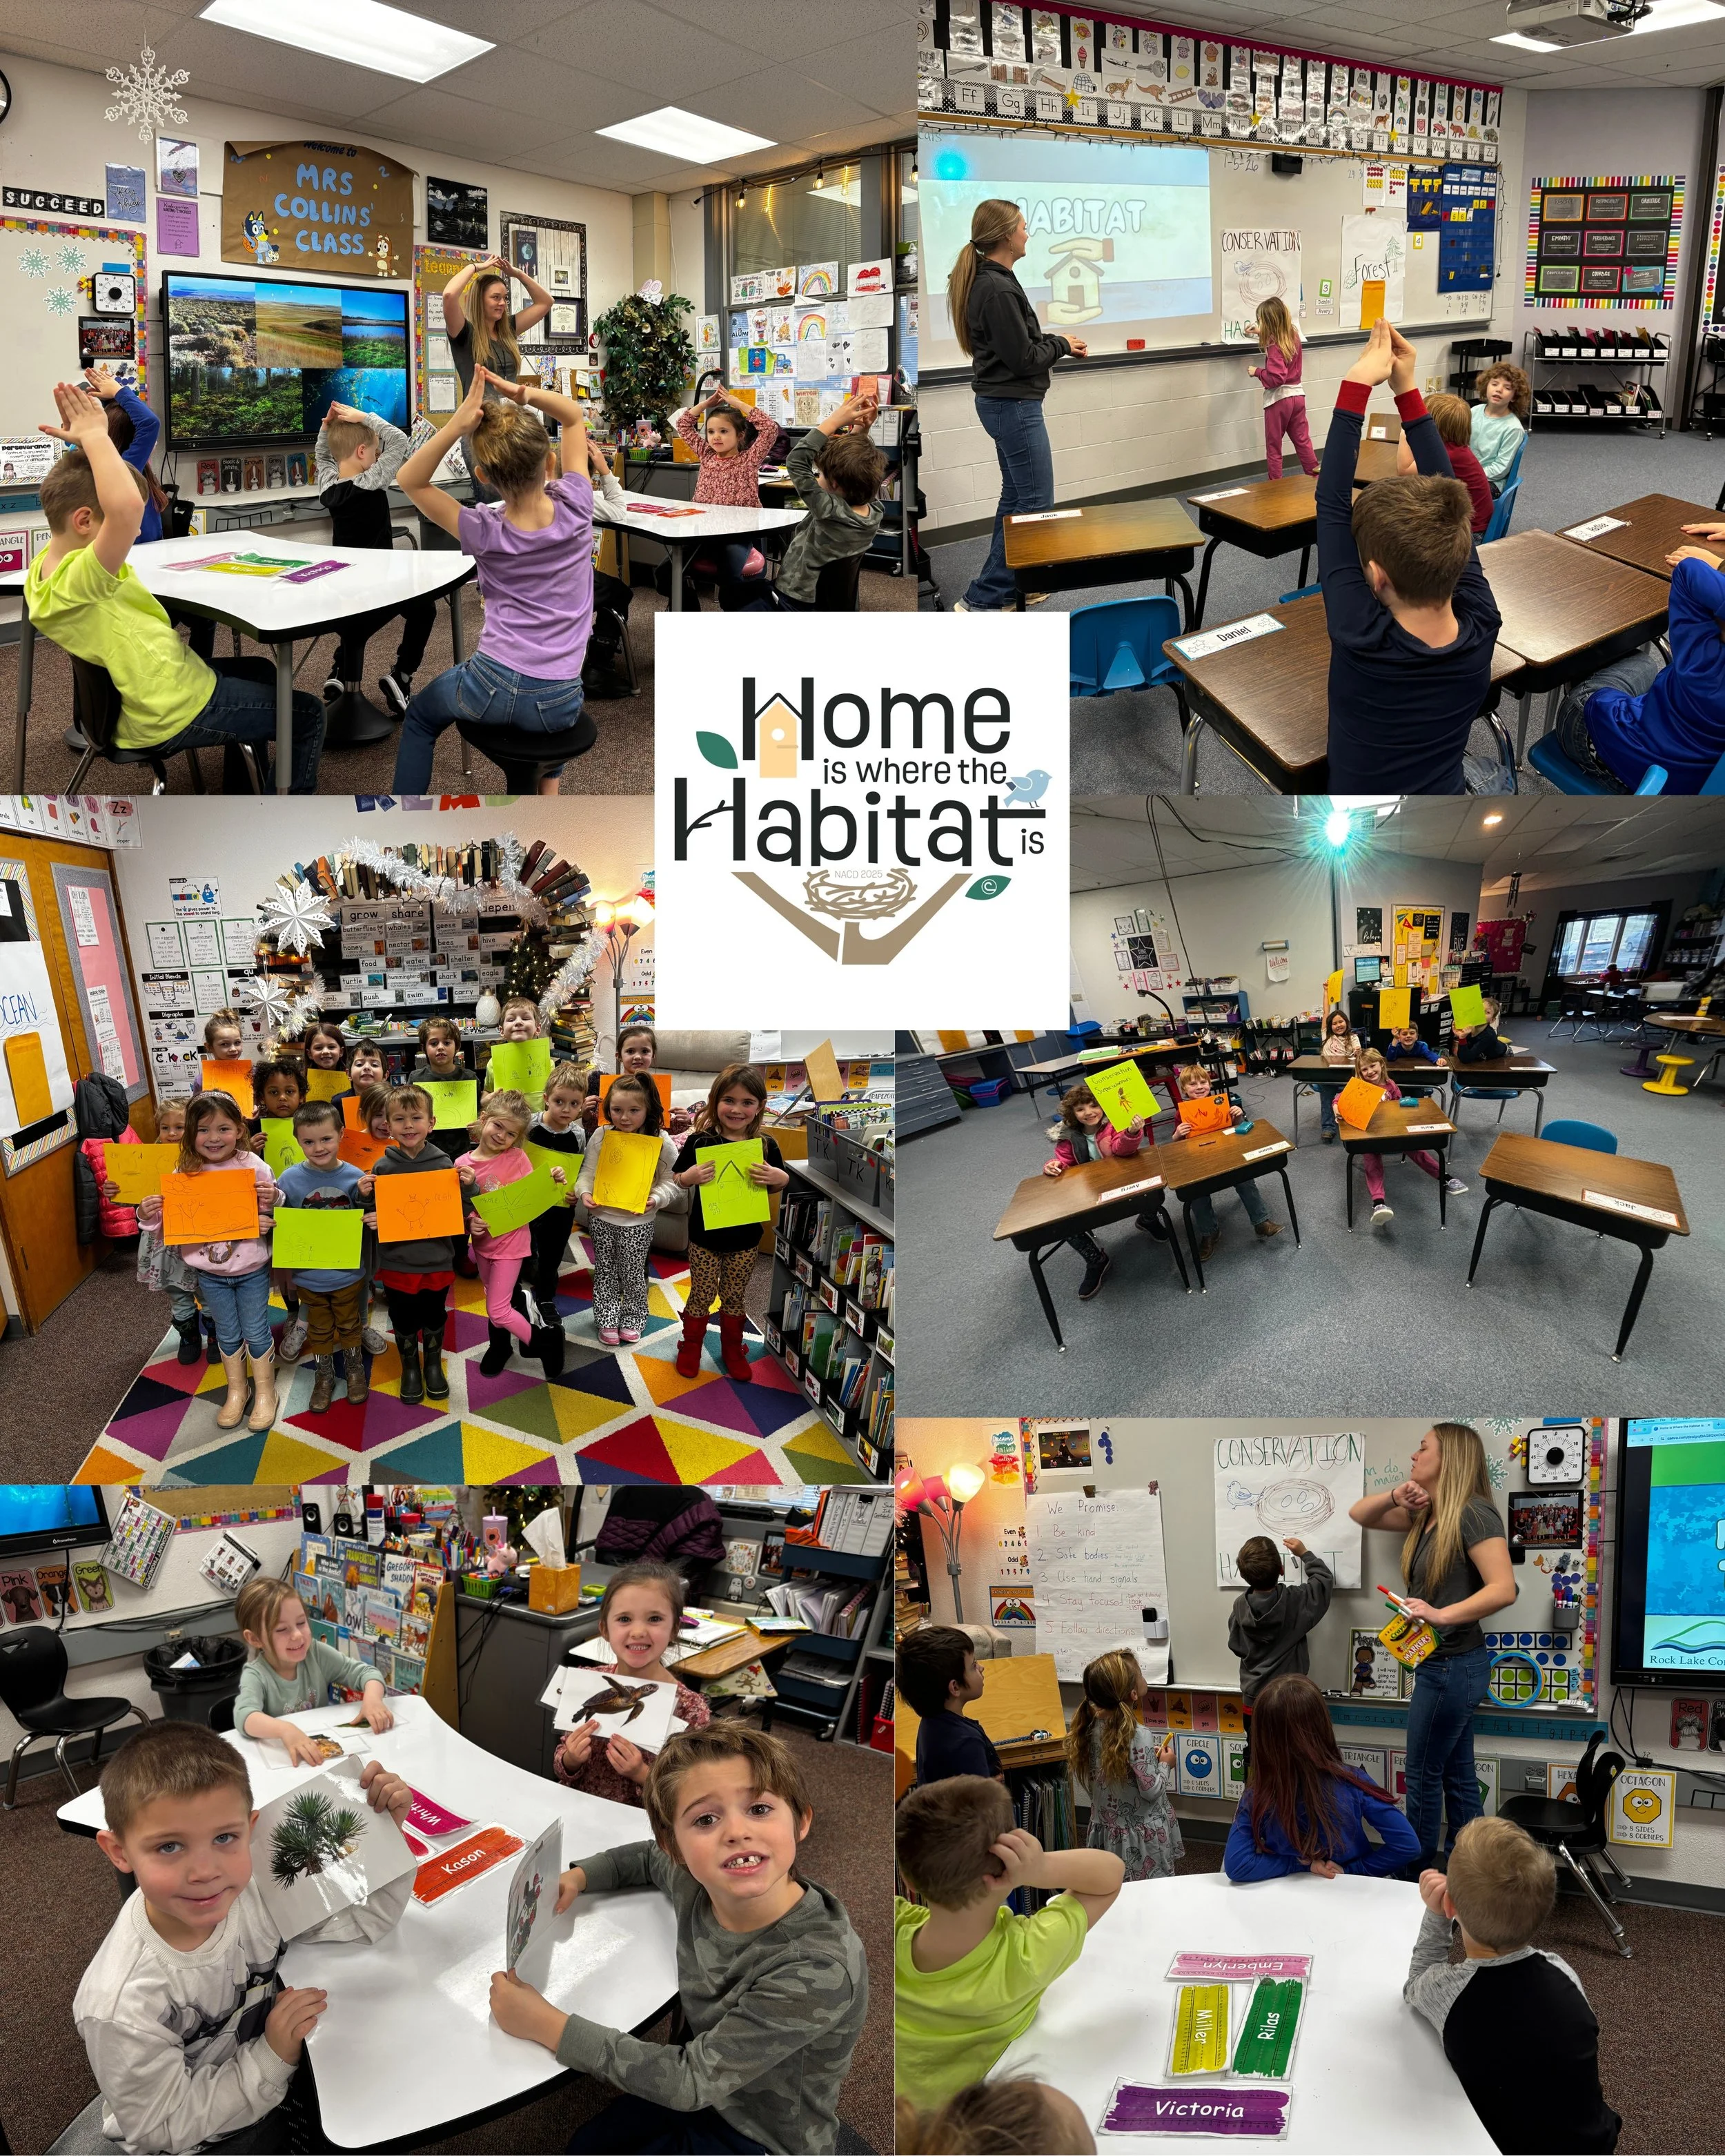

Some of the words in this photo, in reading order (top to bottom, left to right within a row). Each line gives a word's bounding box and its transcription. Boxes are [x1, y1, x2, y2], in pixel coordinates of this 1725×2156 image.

[961, 88, 978, 103] Ff
[1001, 94, 1021, 114] Gg
[1041, 98, 1058, 112] Hh
[1081, 102, 1090, 116] Ii
[1113, 107, 1127, 126] Jj
[1144, 110, 1159, 123] Kk
[1177, 113, 1187, 126] Ll
[1202, 116, 1221, 130] Mm
[1232, 118, 1246, 131] Nn
[1259, 123, 1272, 135] Oo
[1308, 127, 1321, 141] Qq
[1355, 132, 1364, 144] Ss
[1396, 137, 1406, 148] Uu
[1416, 139, 1426, 150] Vv
[1432, 141, 1446, 152] Ww
[1452, 143, 1461, 154] Xx
[1469, 145, 1479, 158] Yy
[1486, 147, 1494, 157] Zz
[304, 141, 345, 156] Welcome
[346, 146, 357, 158] to
[1223, 157, 1259, 172] 1-5-26
[296, 163, 353, 196] MRS
[6, 191, 103, 215] SUCCEED
[274, 193, 374, 228] COLLINS'
[295, 230, 364, 255] CLASS
[1221, 231, 1301, 253] CONSERVATION
[1354, 253, 1392, 284] Forest
[1323, 284, 1329, 293] 3
[1, 443, 52, 451] perseverance
[268, 457, 282, 466] Grey
[1216, 626, 1252, 642] Daniel
[110, 801, 128, 814] Zz
[350, 911, 378, 922] grow
[391, 908, 424, 918] share
[1363, 931, 1381, 943] Believe
[1453, 938, 1464, 951] BIG
[450, 955, 475, 963] shelter
[1268, 956, 1289, 969] Welcome
[243, 969, 254, 977] qu
[388, 973, 420, 982] hummingbird
[1091, 1066, 1132, 1085] Conservation
[814, 1138, 829, 1160] TK
[847, 1157, 864, 1183] TK
[1120, 1183, 1140, 1193] Avery
[1614, 1199, 1637, 1211] Jack
[992, 1434, 1014, 1443] Dreams
[1217, 1433, 1362, 1470] CONSERVATION
[1384, 1458, 1399, 1474] do
[1374, 1472, 1404, 1487] make?
[1047, 1501, 1063, 1515] We
[1053, 1524, 1067, 1538] Be
[1076, 1523, 1096, 1537] kind
[346, 1549, 377, 1566] FRANKENSTEIN
[1056, 1547, 1077, 1559] Safe
[1085, 1547, 1109, 1560] bodies
[75, 1564, 105, 1575] Green
[386, 1561, 414, 1572] GREGORY
[1, 1574, 29, 1586] Pink
[37, 1568, 68, 1581] Orange
[1058, 1570, 1076, 1583] Use
[1084, 1571, 1102, 1583] hand
[1110, 1572, 1138, 1588] signals
[420, 1577, 437, 1586] WINTER
[1059, 1593, 1083, 1612] Stay
[1089, 1592, 1123, 1606] focused
[1061, 1621, 1088, 1634] Follow
[1095, 1621, 1136, 1635] directions
[1403, 1633, 1432, 1662] MARKERS
[1650, 1654, 1677, 1665] Rock
[1679, 1654, 1706, 1666] Lake
[1678, 1702, 1703, 1714] Red
[1186, 1739, 1210, 1749] CIRCLE
[1343, 1752, 1381, 1763] TRIANGLE
[1620, 1774, 1666, 1787] OCTAGON
[1635, 1833, 1664, 1841] CORNERS
[440, 1848, 486, 1875] Kason
[1202, 1960, 1284, 1971] Emberlyn
[1194, 2008, 1214, 2045] Miller
[1257, 2012, 1281, 2040] Rilas
[1154, 2100, 1245, 2119] Victoria
